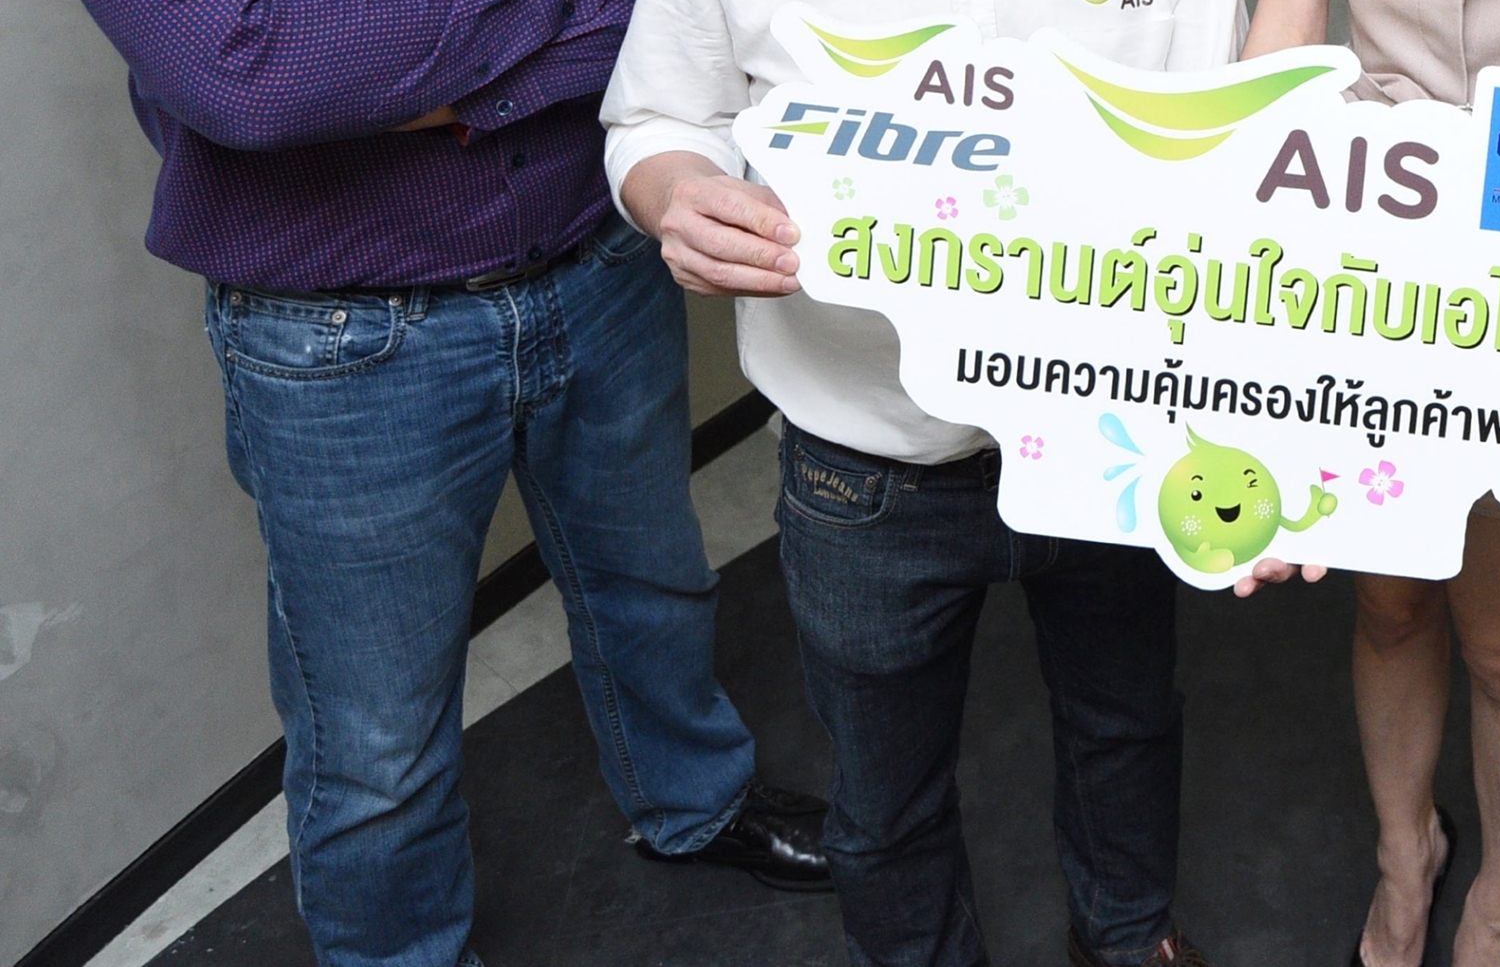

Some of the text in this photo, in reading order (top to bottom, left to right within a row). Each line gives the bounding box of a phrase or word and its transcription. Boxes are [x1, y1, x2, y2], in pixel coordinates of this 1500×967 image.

[914, 59, 1016, 111] AIS
[763, 101, 1011, 171] Fibre
[1255, 128, 1440, 221] AIS
